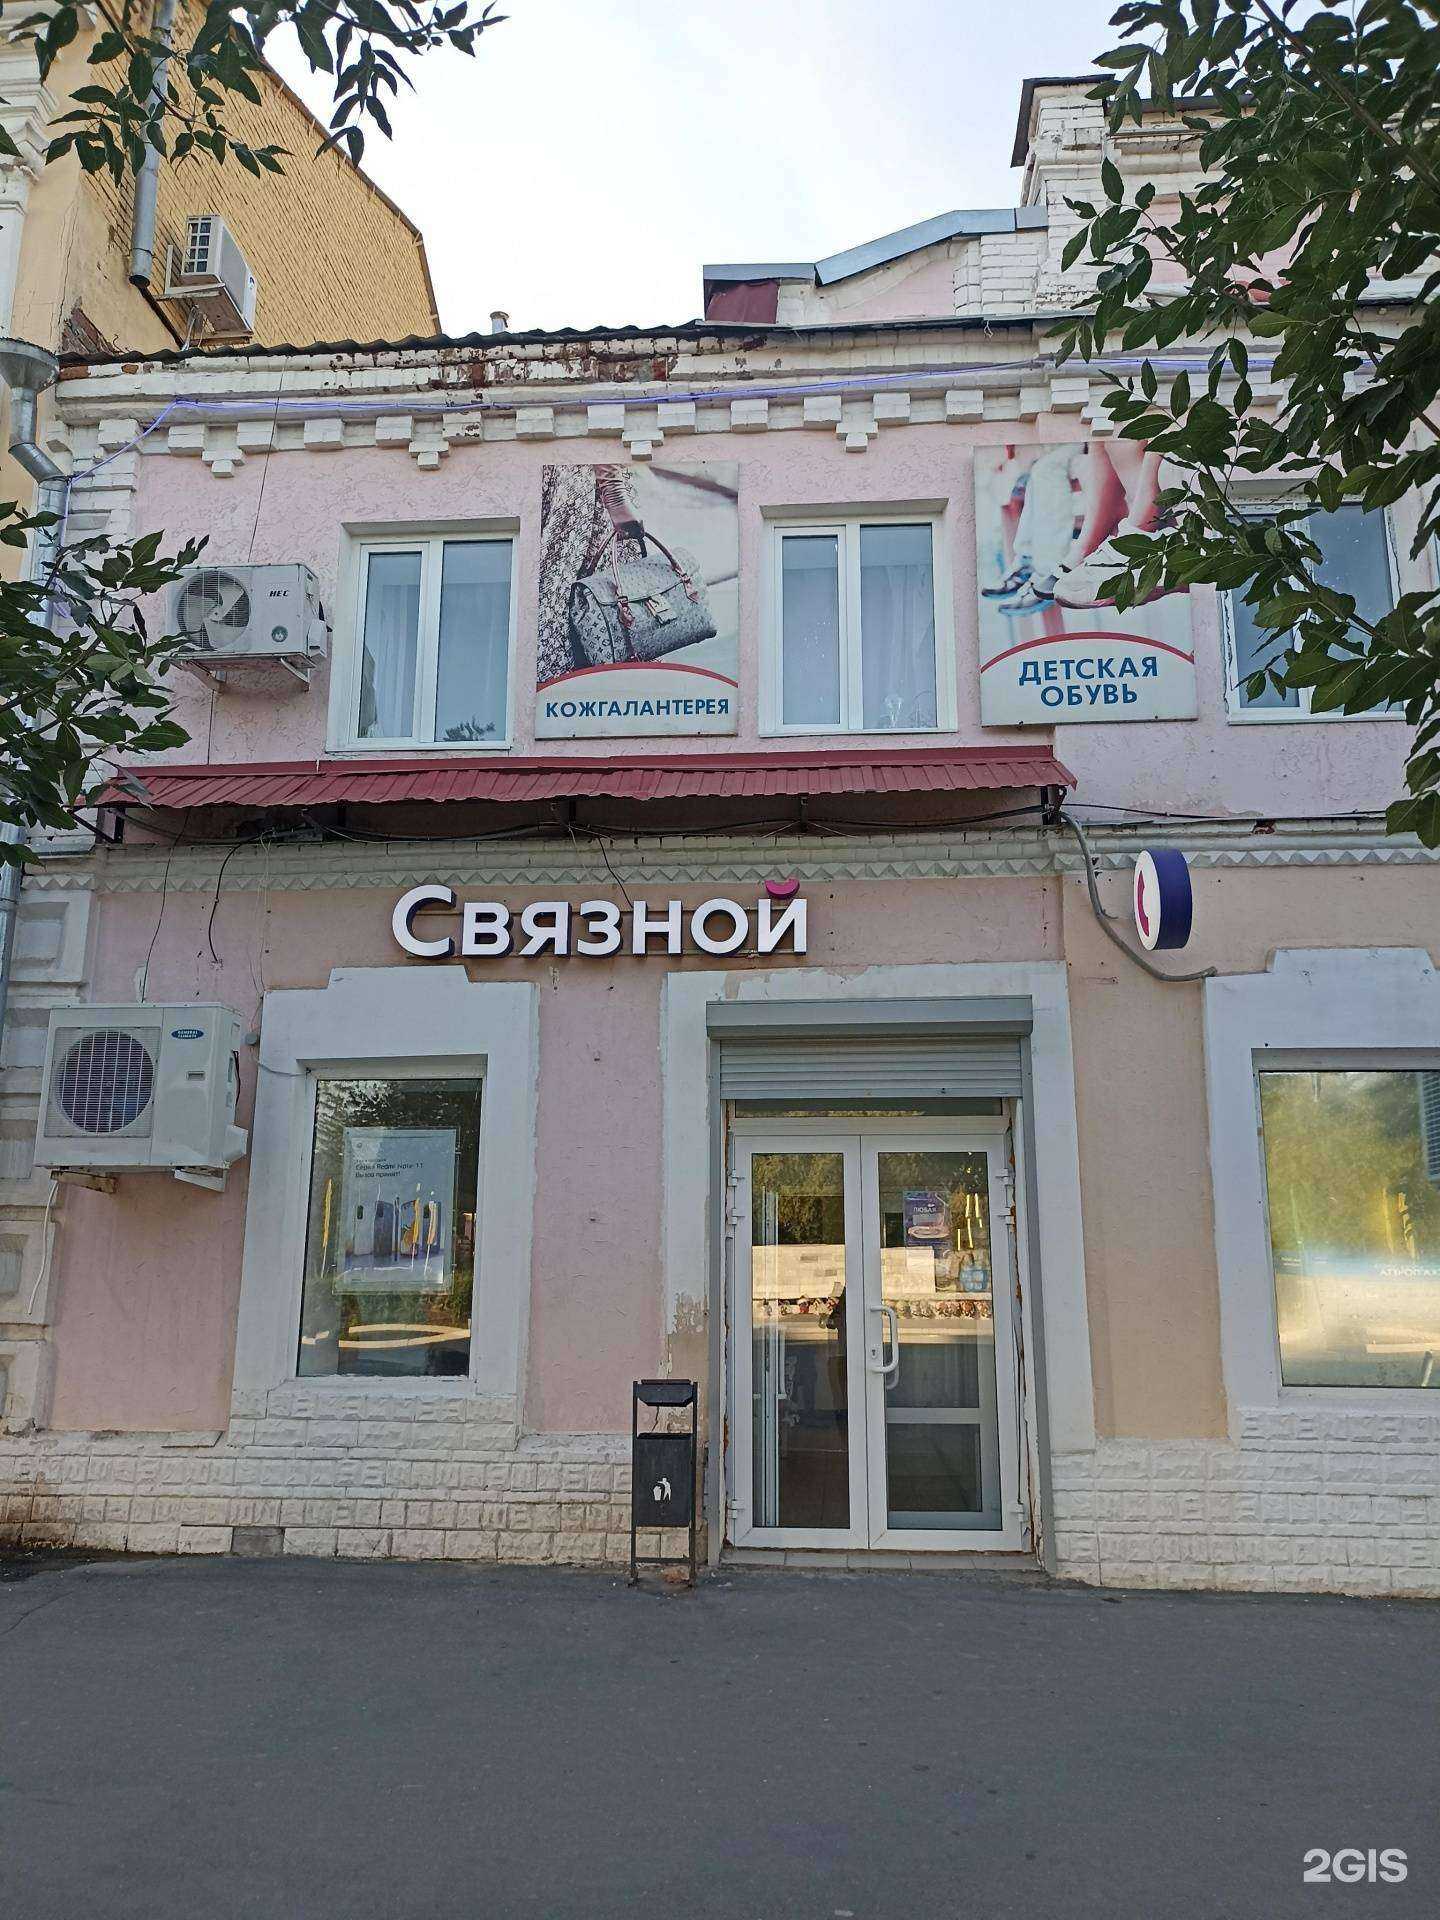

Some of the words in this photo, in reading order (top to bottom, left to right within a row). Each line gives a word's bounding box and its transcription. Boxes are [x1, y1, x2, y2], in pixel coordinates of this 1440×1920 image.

[1019, 656, 1158, 686] ДЕТСКАЯ
[1041, 683, 1138, 707] ОБУВЬ
[546, 699, 729, 718] КОЖГАЛАНТЕРЕЯ
